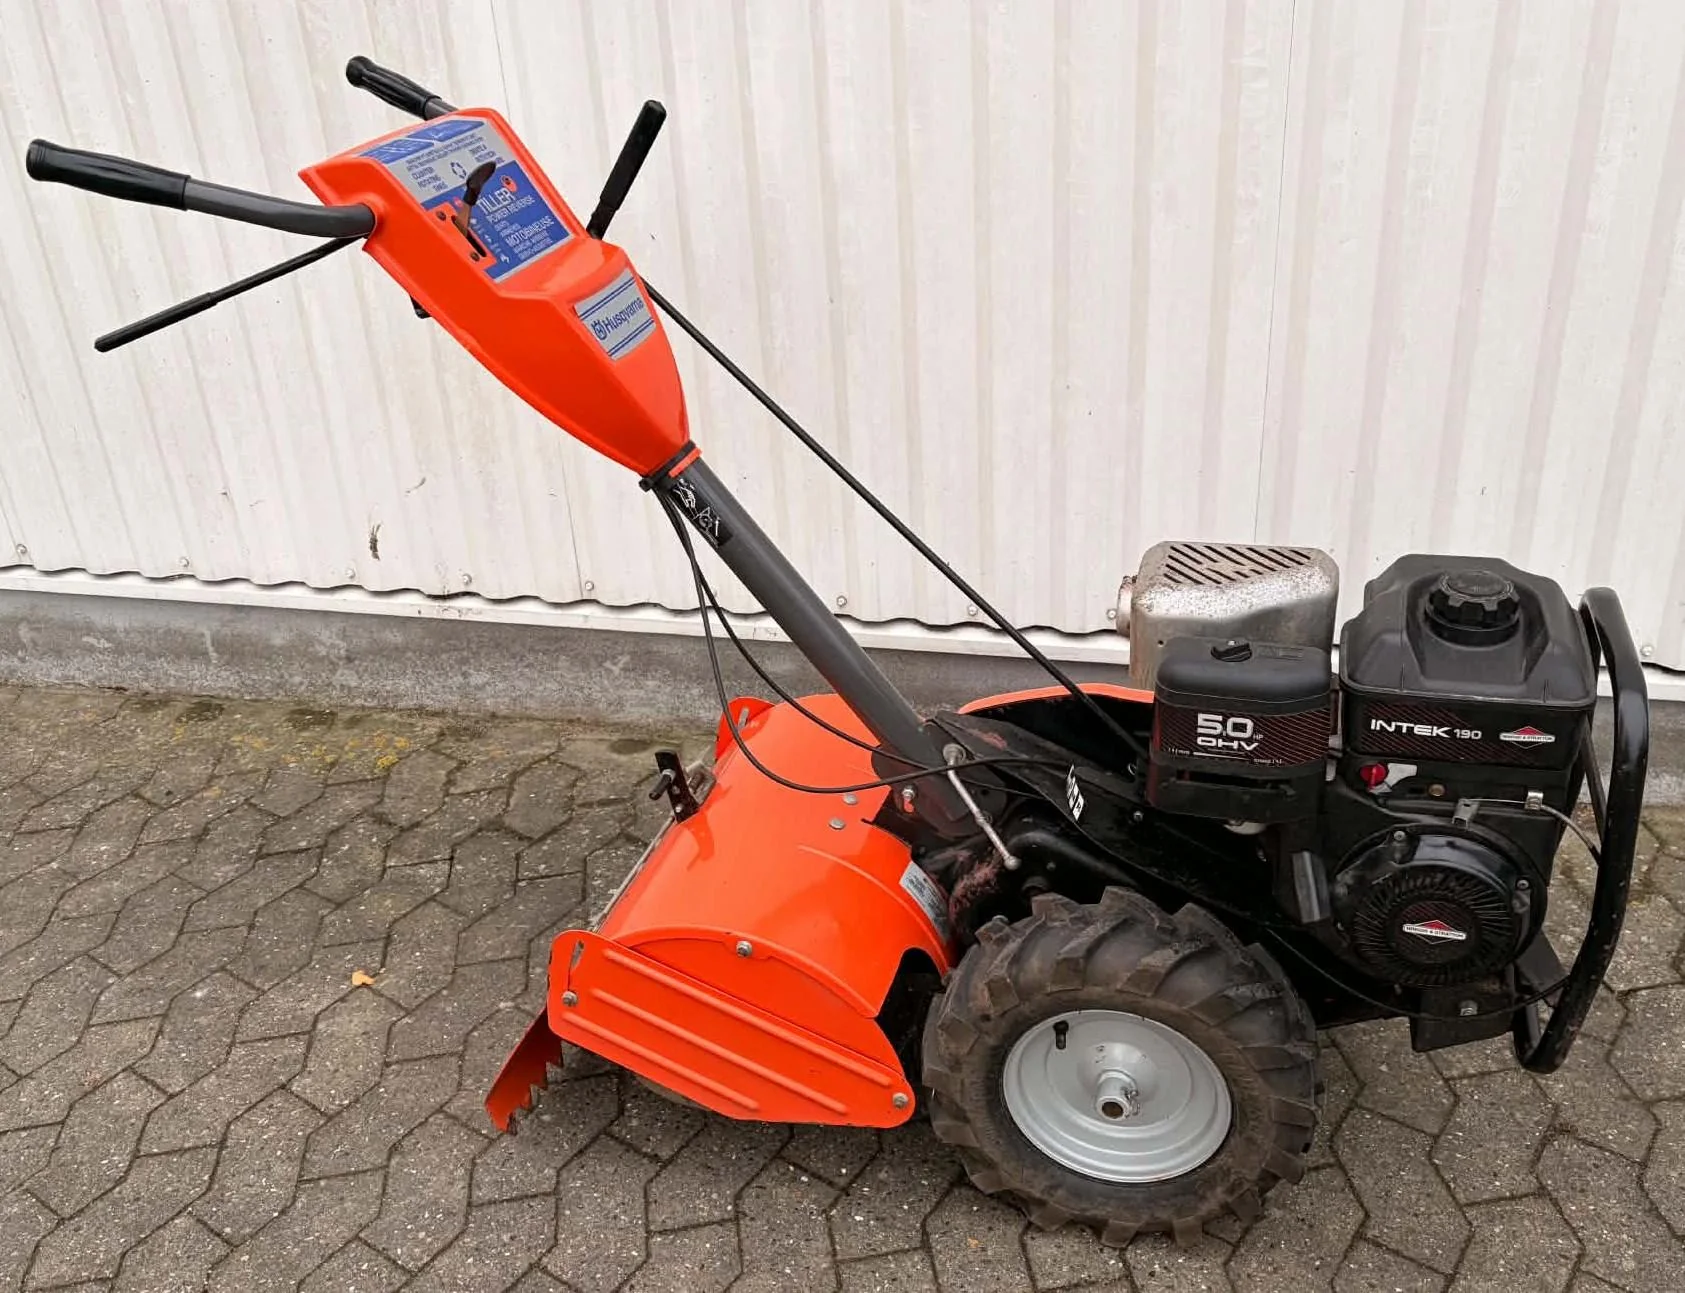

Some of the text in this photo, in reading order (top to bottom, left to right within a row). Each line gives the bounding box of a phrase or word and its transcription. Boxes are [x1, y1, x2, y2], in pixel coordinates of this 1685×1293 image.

[475, 187, 516, 215] TILLER
[602, 296, 644, 334] Husqvarna
[1196, 712, 1254, 739] 5.0
[1370, 718, 1482, 740] INTEK 190
[1196, 736, 1259, 751] OHV
